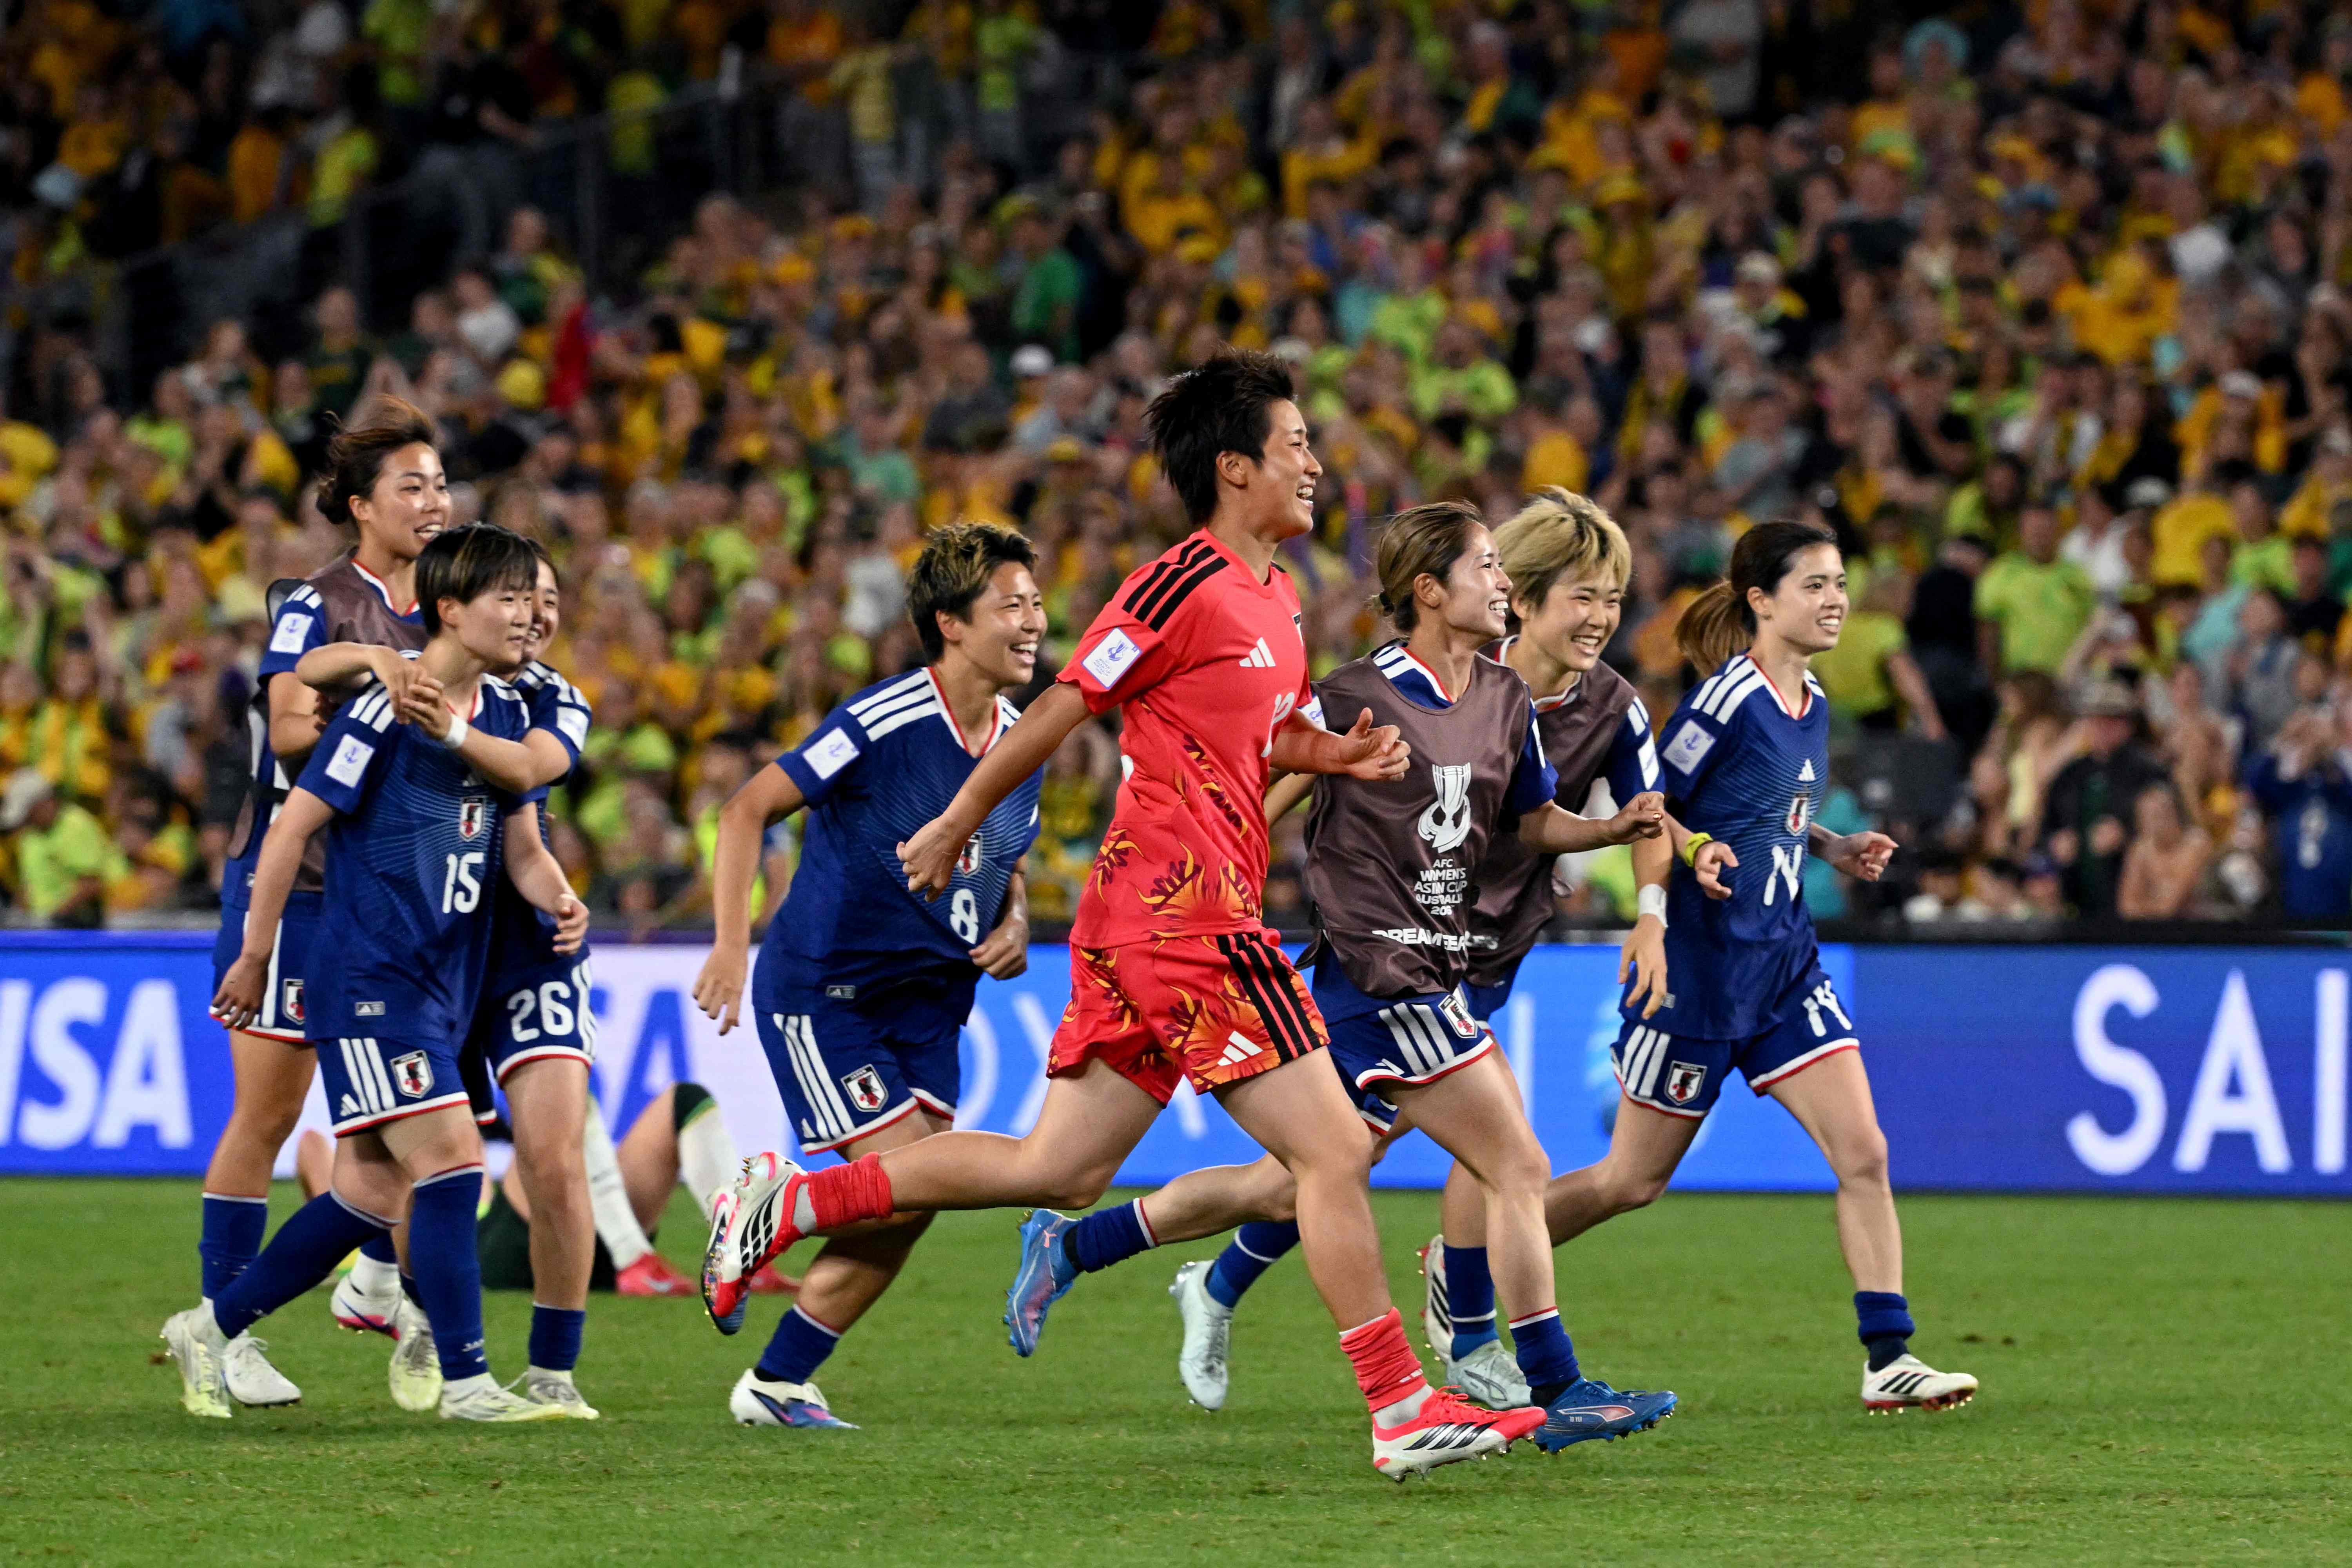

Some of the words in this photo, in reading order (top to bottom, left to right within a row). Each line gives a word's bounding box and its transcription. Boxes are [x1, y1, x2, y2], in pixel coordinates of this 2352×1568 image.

[443, 852, 484, 913] 15
[1414, 881, 1445, 894] ASIN
[1446, 880, 1468, 893] CUP
[1433, 859, 1453, 867] AFC
[950, 888, 978, 944] 8
[507, 981, 574, 1042] 26
